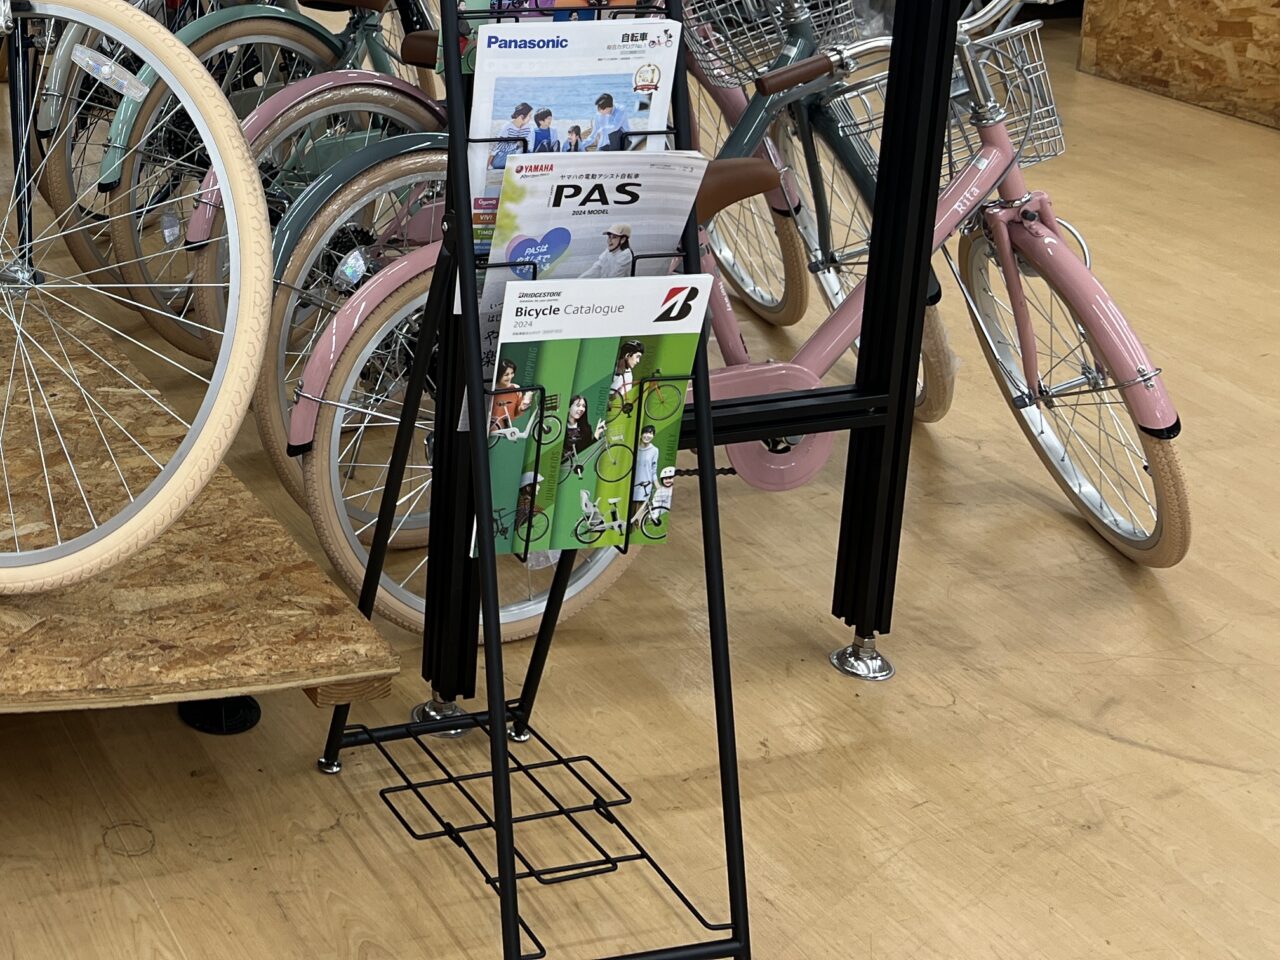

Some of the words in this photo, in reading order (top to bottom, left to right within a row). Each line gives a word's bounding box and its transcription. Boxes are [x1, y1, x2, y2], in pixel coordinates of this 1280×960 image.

[486, 35, 568, 49] Panasonic
[621, 32, 648, 43] 自転車
[524, 163, 554, 173] YAMAHA
[560, 172, 640, 180] ヤマハの電動アシスト自転車
[551, 182, 642, 207] PAS
[954, 187, 980, 215] Rita
[518, 291, 562, 299] BRIDGESTONE
[515, 305, 561, 319] Bicycle
[564, 304, 625, 317] Catalogue
[513, 320, 533, 328] 2024
